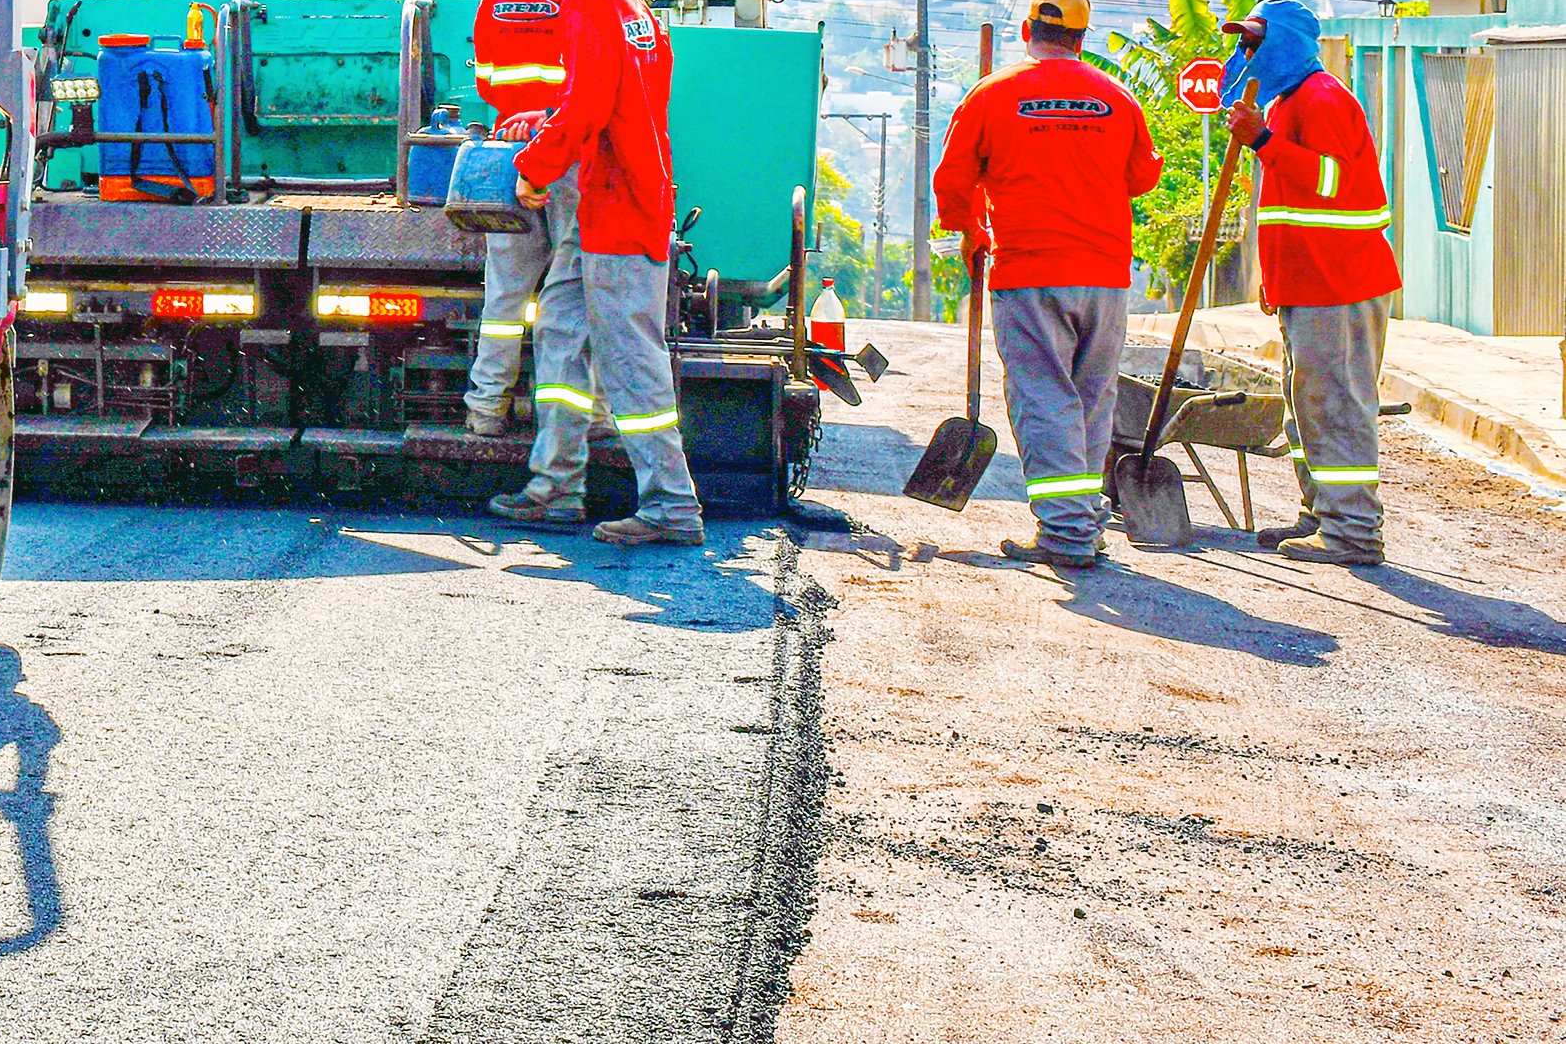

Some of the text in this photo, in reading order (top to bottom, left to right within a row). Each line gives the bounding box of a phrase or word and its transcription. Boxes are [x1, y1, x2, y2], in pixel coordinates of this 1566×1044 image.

[493, 2, 552, 15] ARENA
[1183, 78, 1217, 93] PAR
[1018, 100, 1103, 114] ARENA
